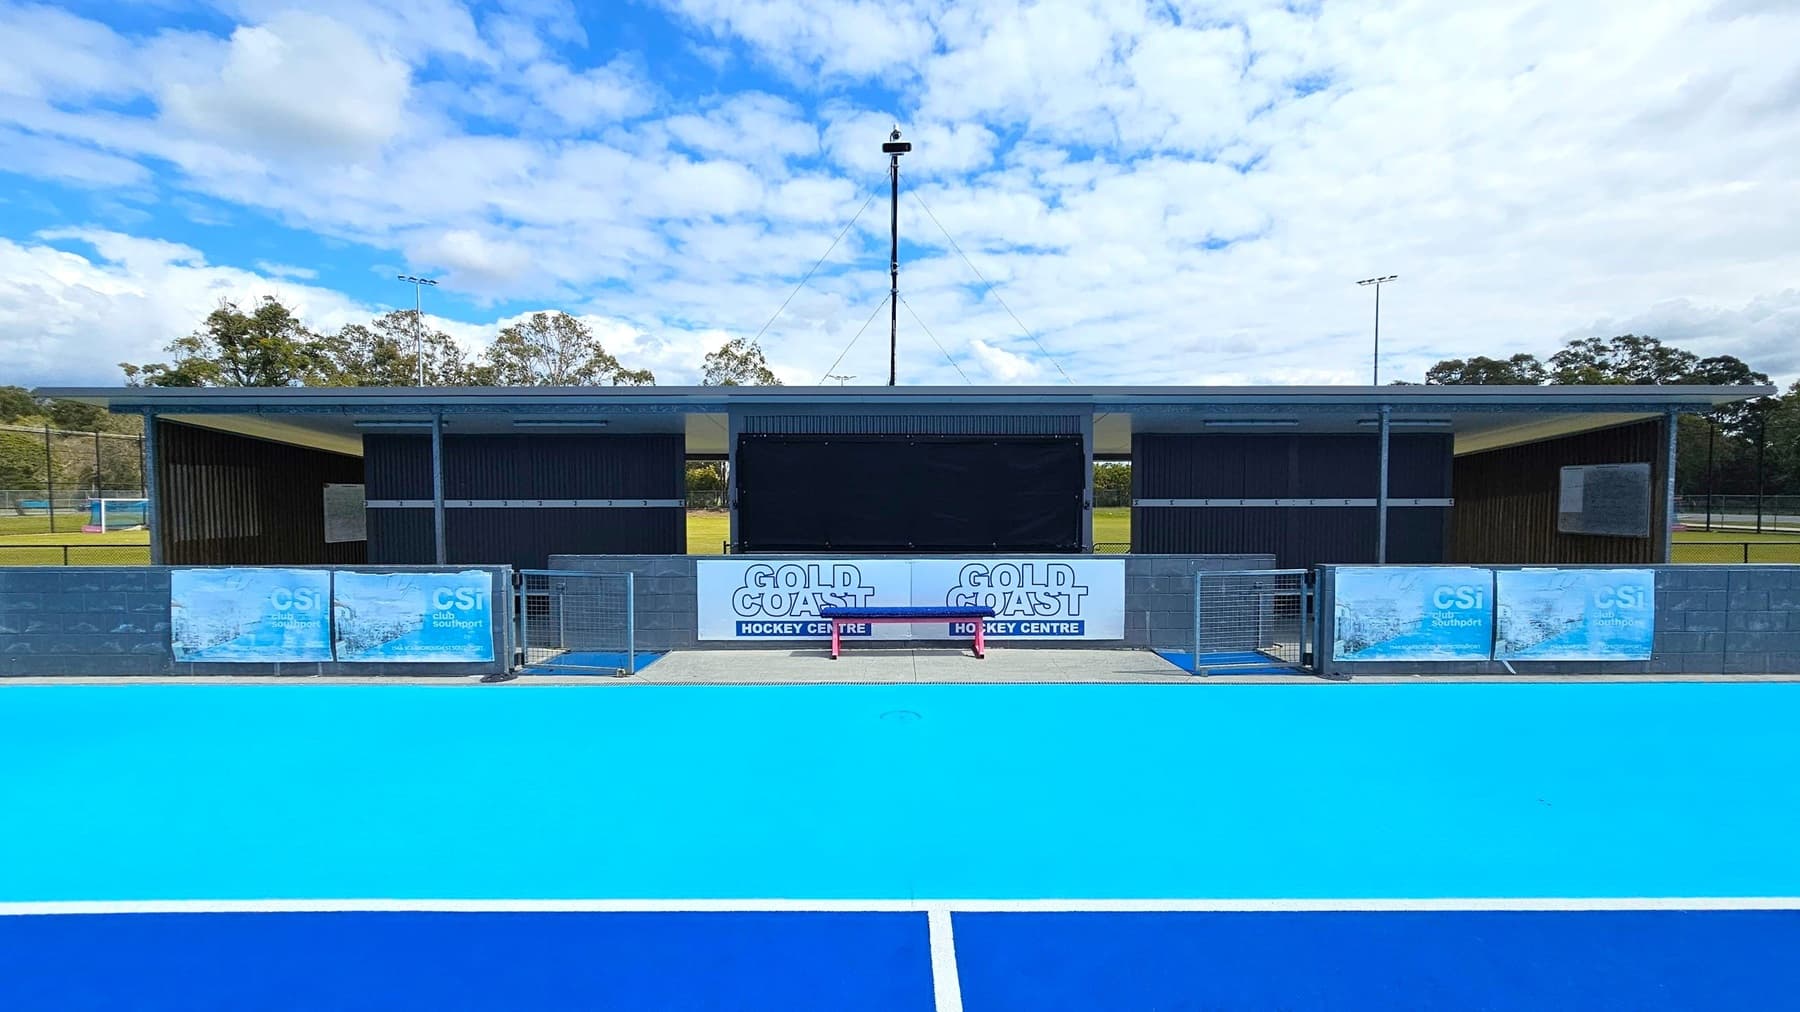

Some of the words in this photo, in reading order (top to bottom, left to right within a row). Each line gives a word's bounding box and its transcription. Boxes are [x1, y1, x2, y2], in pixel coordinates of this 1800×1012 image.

[744, 563, 862, 589] GOLD
[958, 562, 1076, 588] GOLD
[732, 587, 875, 617] COAST
[946, 586, 1089, 617] COAST
[271, 611, 294, 620] club
[432, 611, 455, 620] club
[1431, 610, 1455, 619] club
[271, 620, 321, 629] southport
[432, 620, 483, 629] southport
[955, 622, 1015, 634] HOKEY
[1020, 622, 1079, 634] CENTRE
[1431, 619, 1482, 628] southport
[741, 623, 803, 635] HOCKEY
